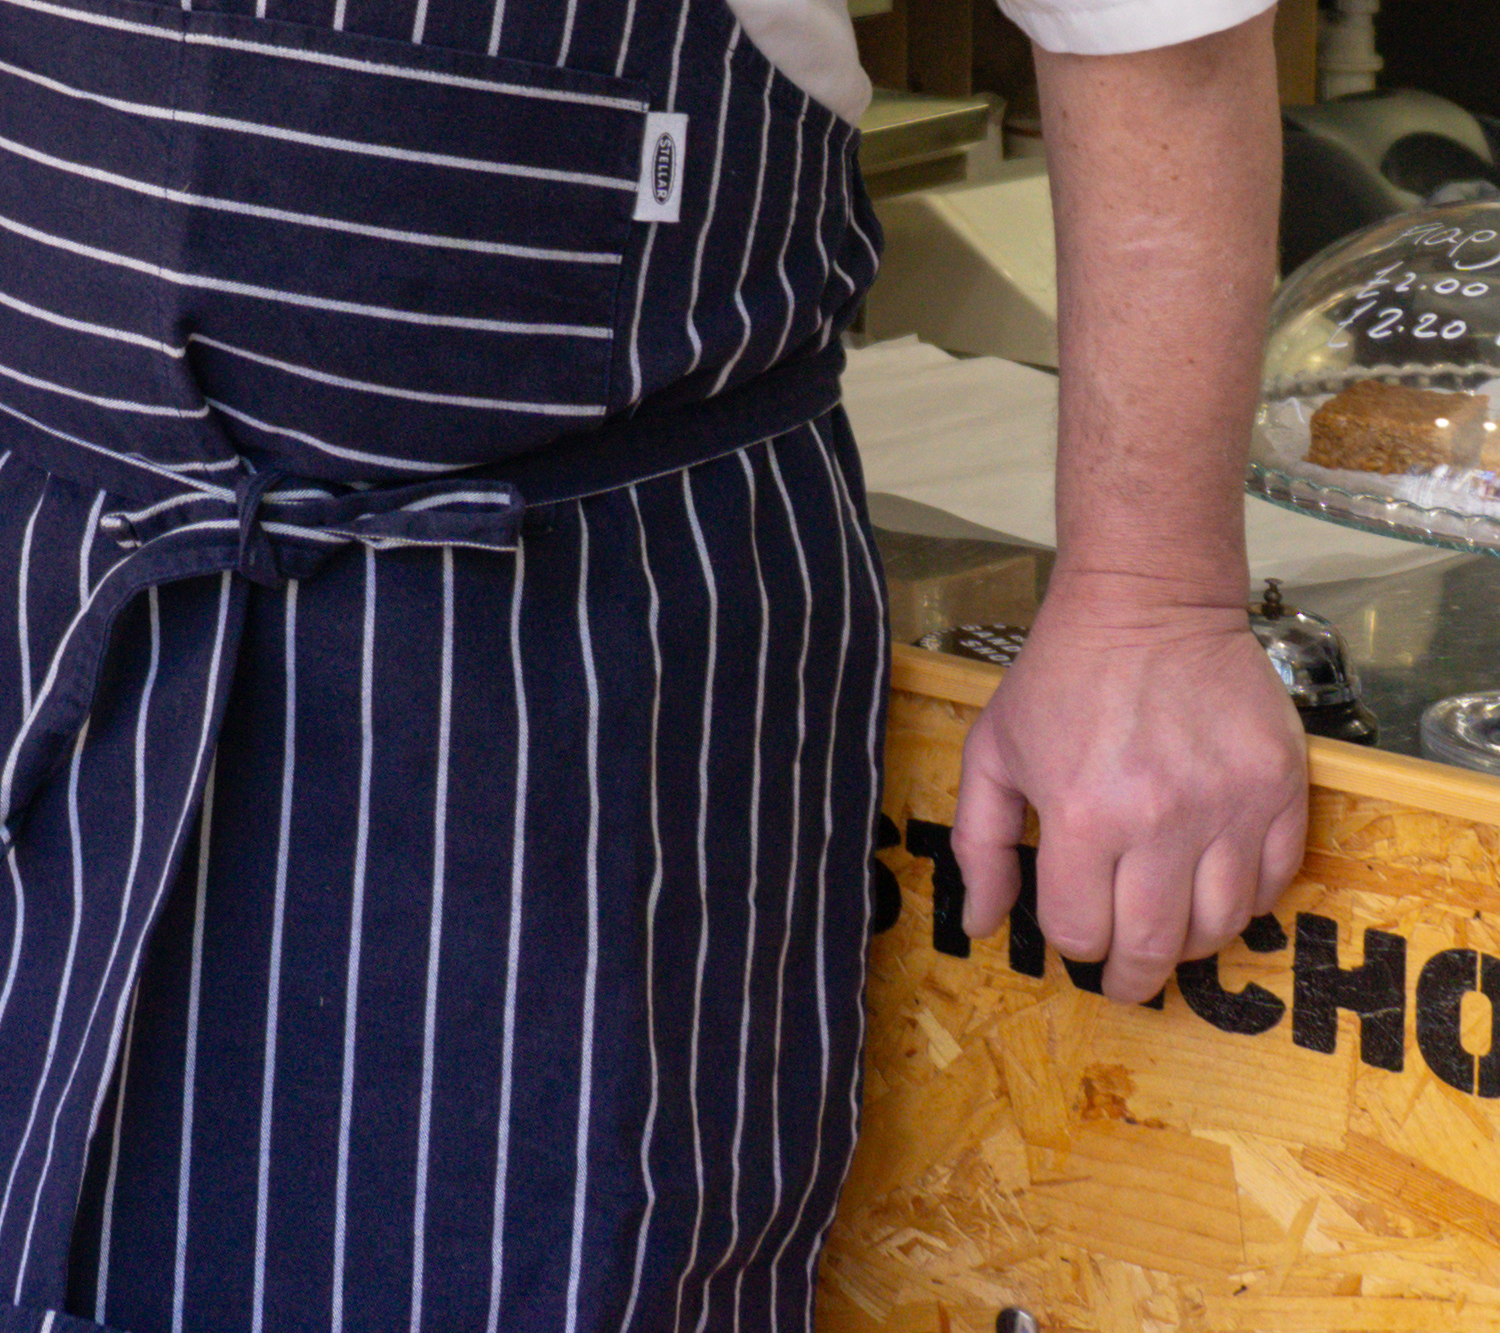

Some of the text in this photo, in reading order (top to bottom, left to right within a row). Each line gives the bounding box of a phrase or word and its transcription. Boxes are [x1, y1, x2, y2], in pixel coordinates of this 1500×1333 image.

[658, 139, 672, 198] STELLAR
[1356, 261, 1489, 299] £2.00
[1326, 299, 1467, 348] £2.20
